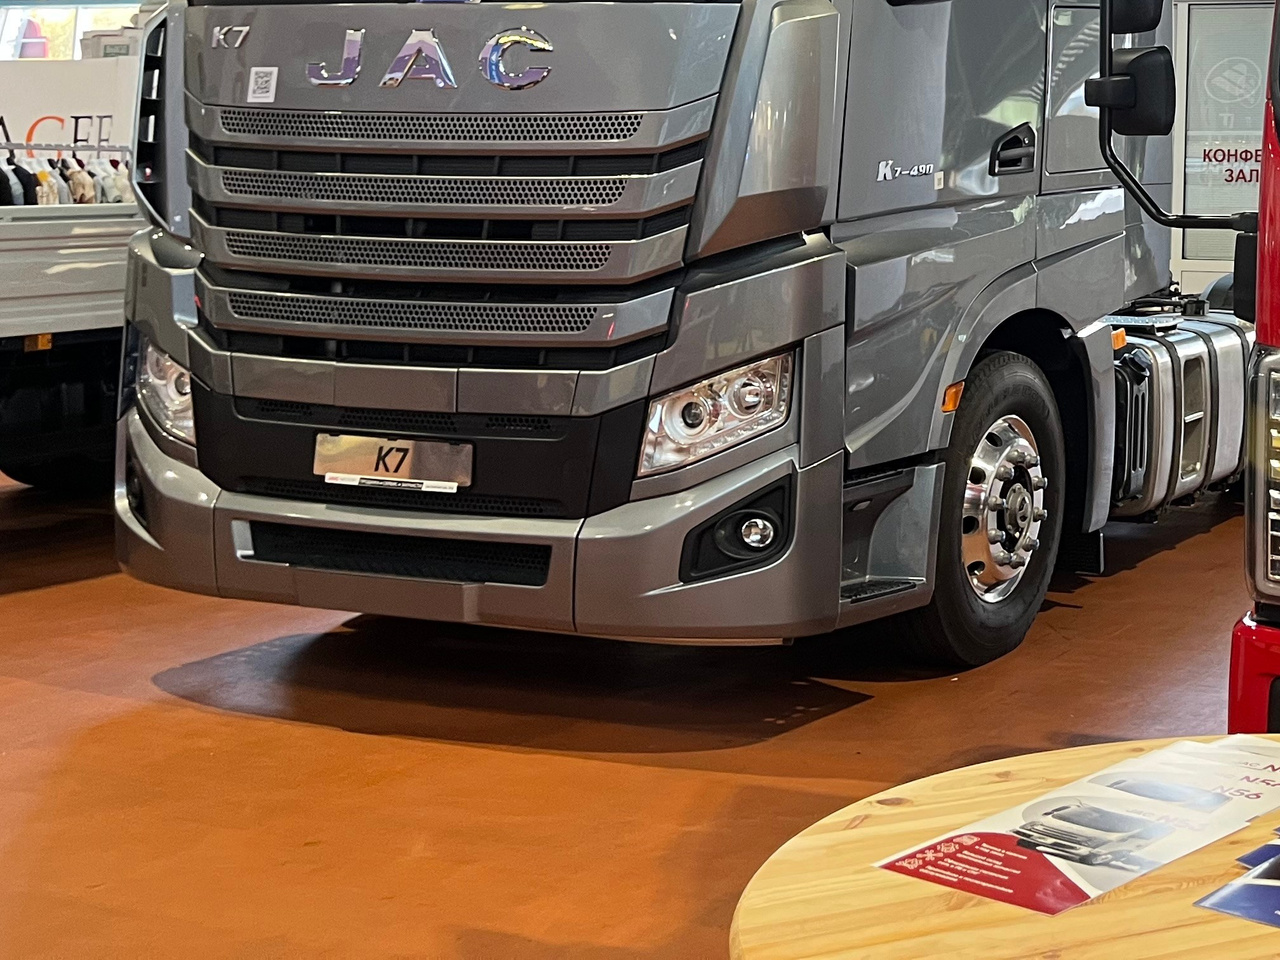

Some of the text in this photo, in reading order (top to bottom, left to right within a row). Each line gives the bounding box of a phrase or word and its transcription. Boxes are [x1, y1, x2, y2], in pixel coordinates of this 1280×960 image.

[211, 25, 250, 49] K7
[305, 26, 554, 91] JAC
[1224, 168, 1259, 182] ЗАЛ
[374, 446, 410, 473] K7
